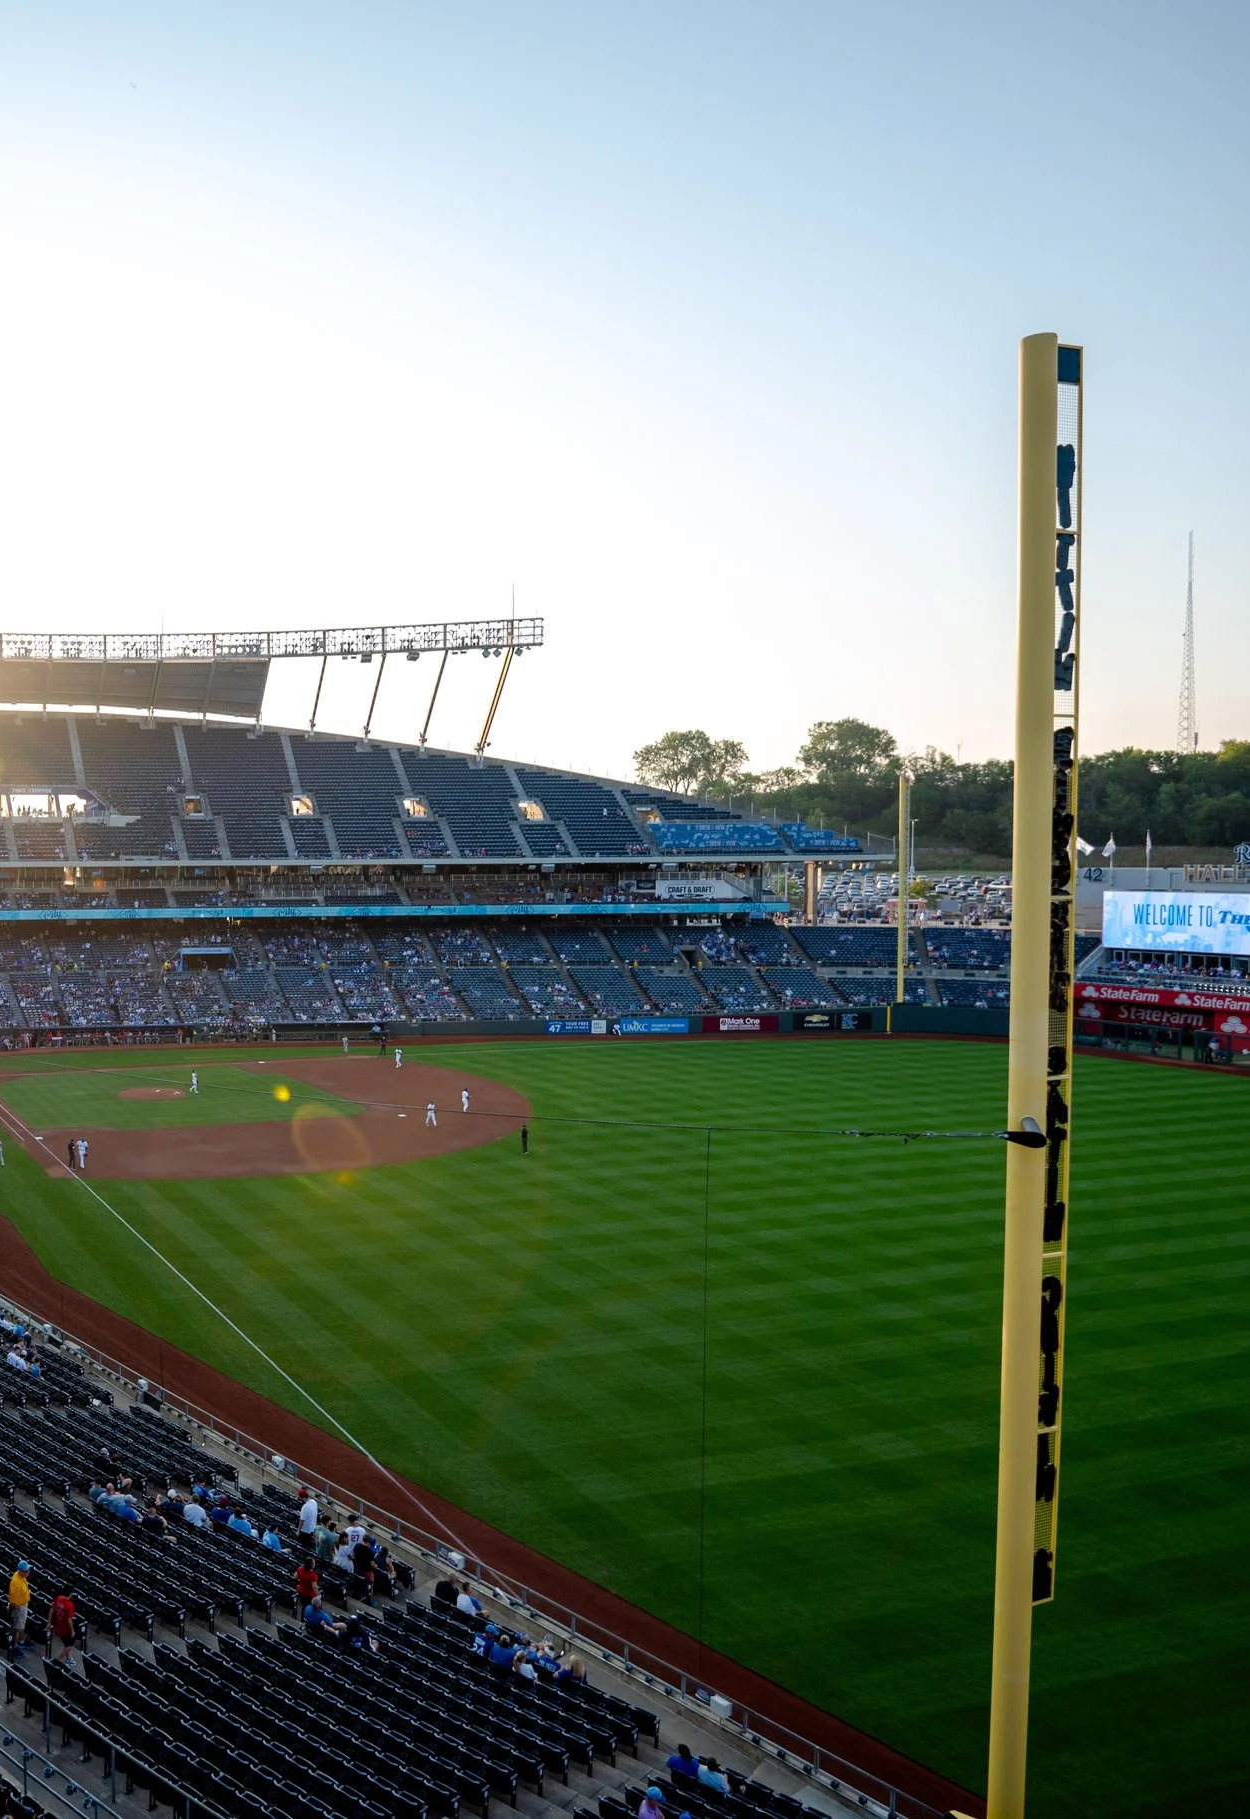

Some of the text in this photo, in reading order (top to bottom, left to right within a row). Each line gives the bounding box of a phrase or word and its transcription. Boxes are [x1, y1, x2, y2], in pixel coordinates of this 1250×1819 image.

[1083, 868, 1103, 882] 42
[1183, 864, 1247, 882] HALL
[1133, 904, 1193, 926] WELCOME
[1199, 905, 1213, 927] TO
[623, 1023, 648, 1031] UMKC
